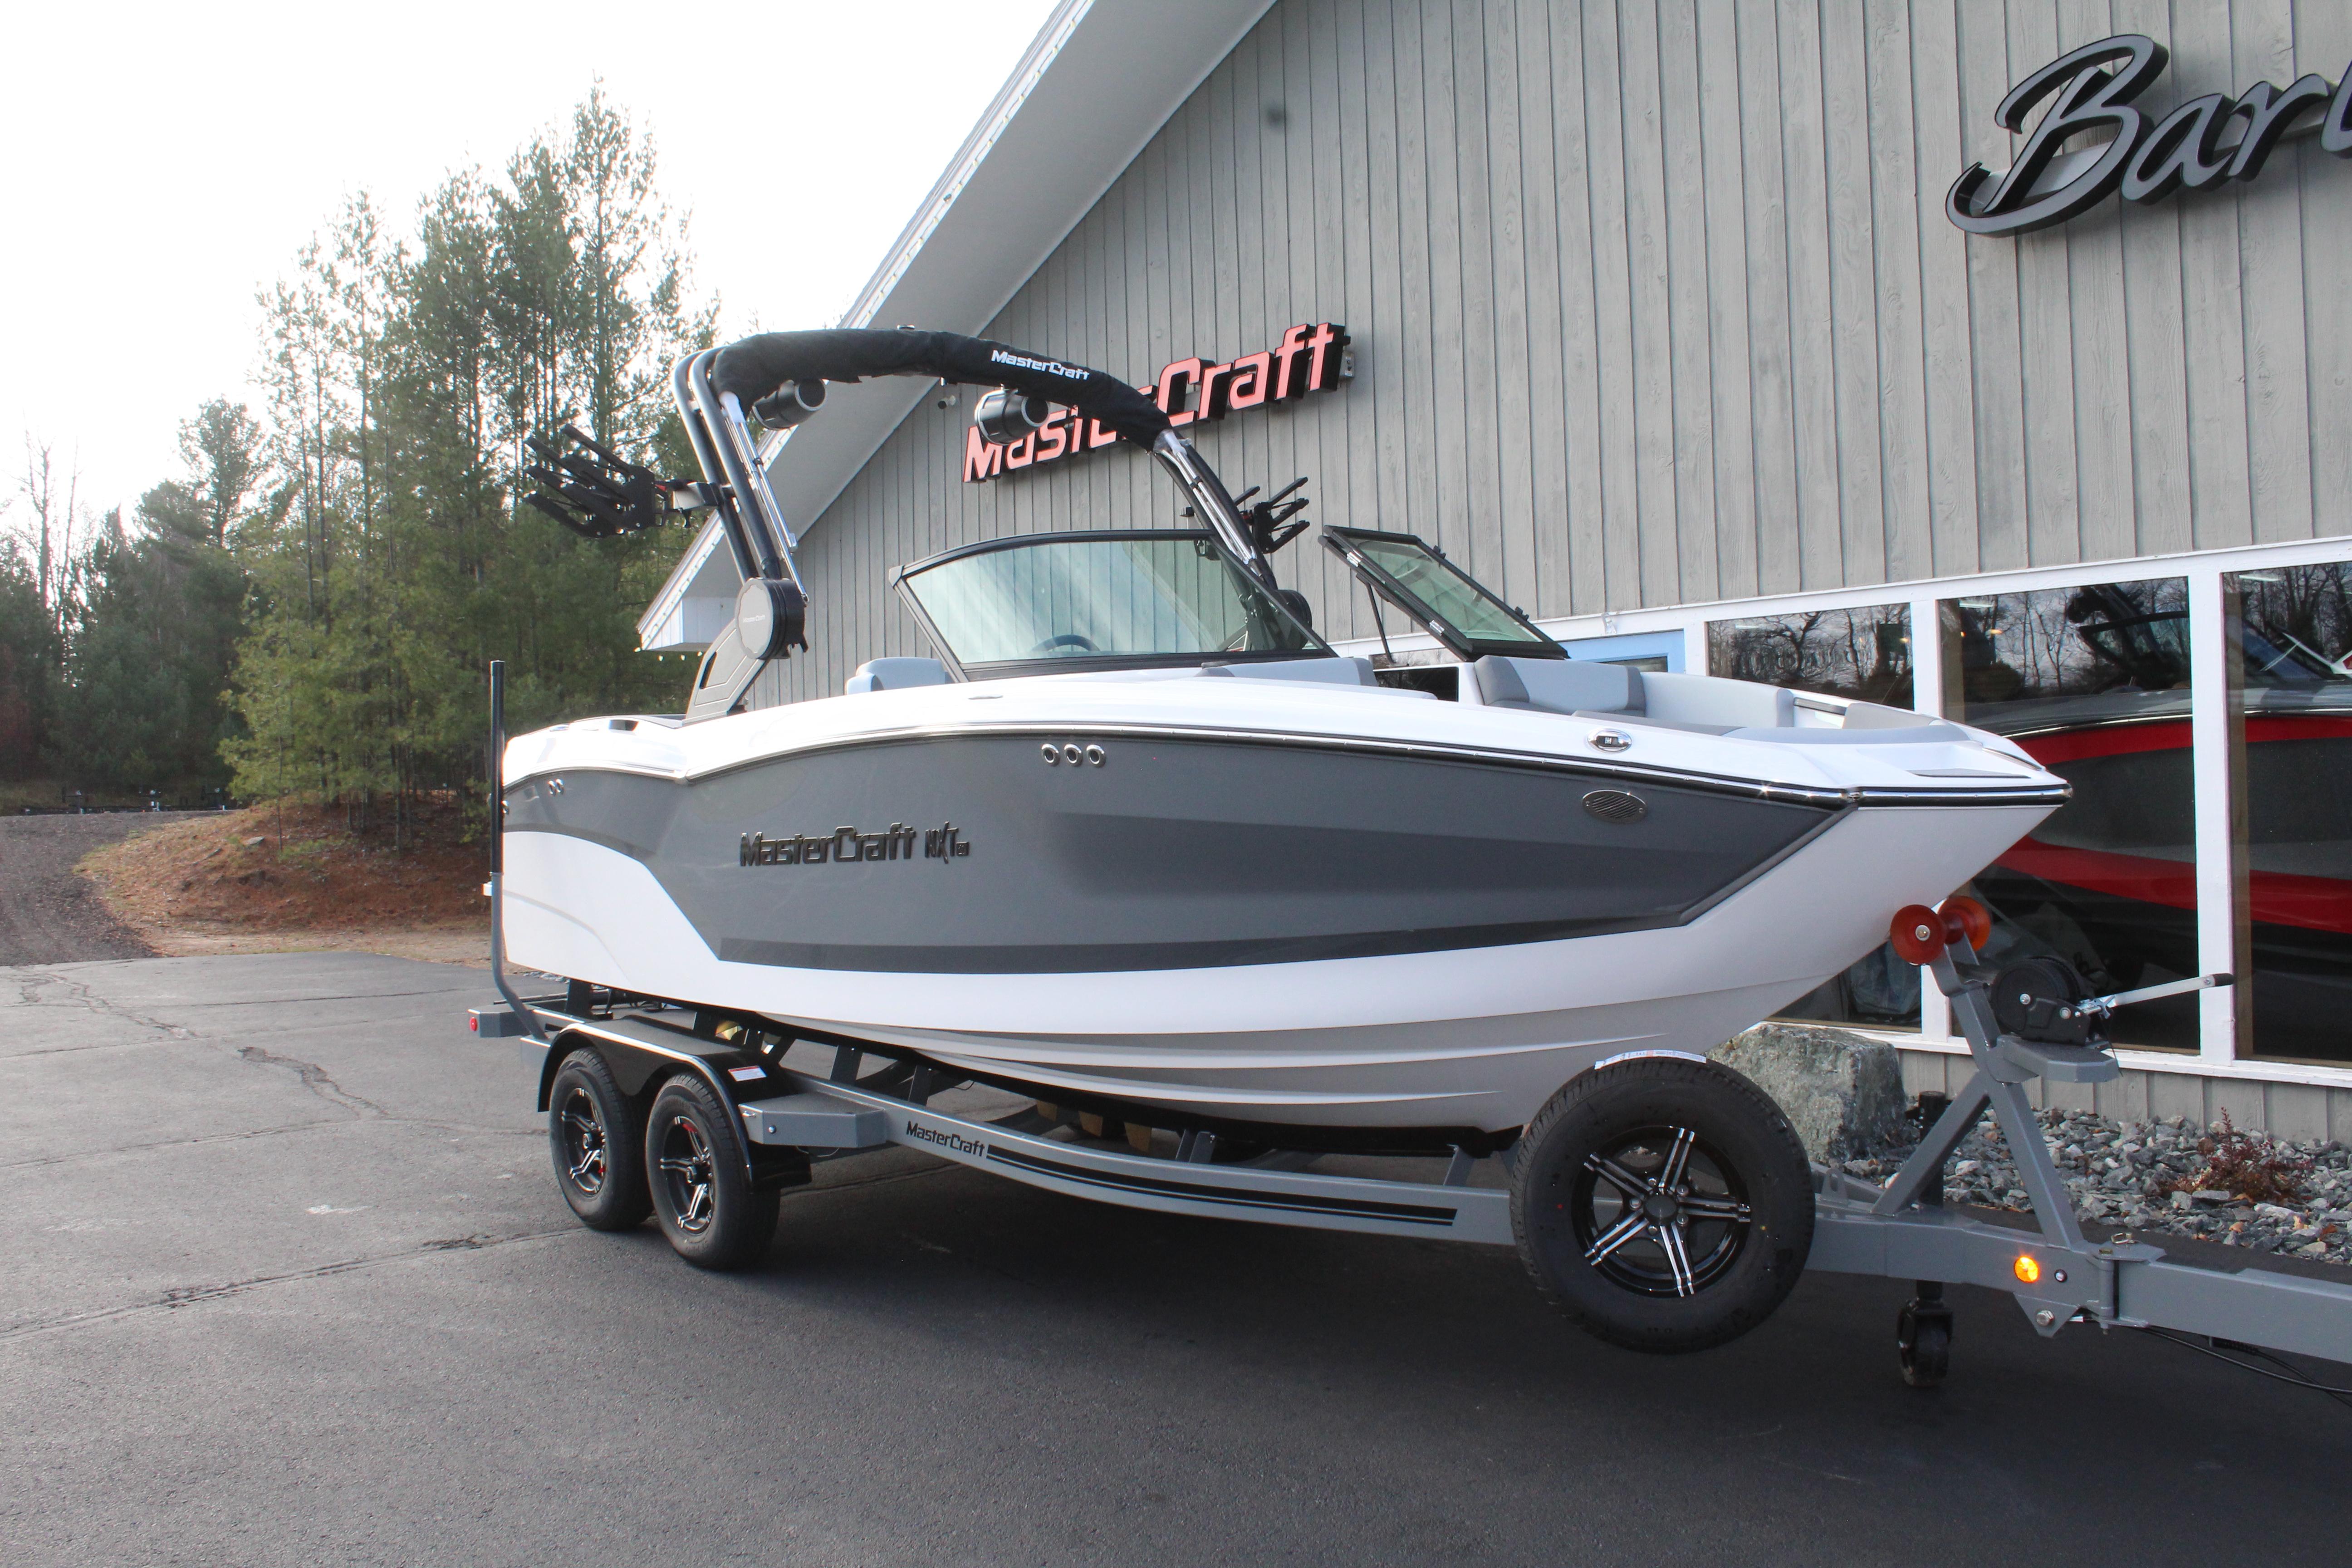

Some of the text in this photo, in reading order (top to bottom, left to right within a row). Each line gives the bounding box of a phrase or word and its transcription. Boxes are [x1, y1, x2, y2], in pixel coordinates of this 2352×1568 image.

[991, 349, 1090, 380] MasterCraft
[740, 822, 916, 867] MasterCraft
[906, 1121, 985, 1157] MasterCraft
